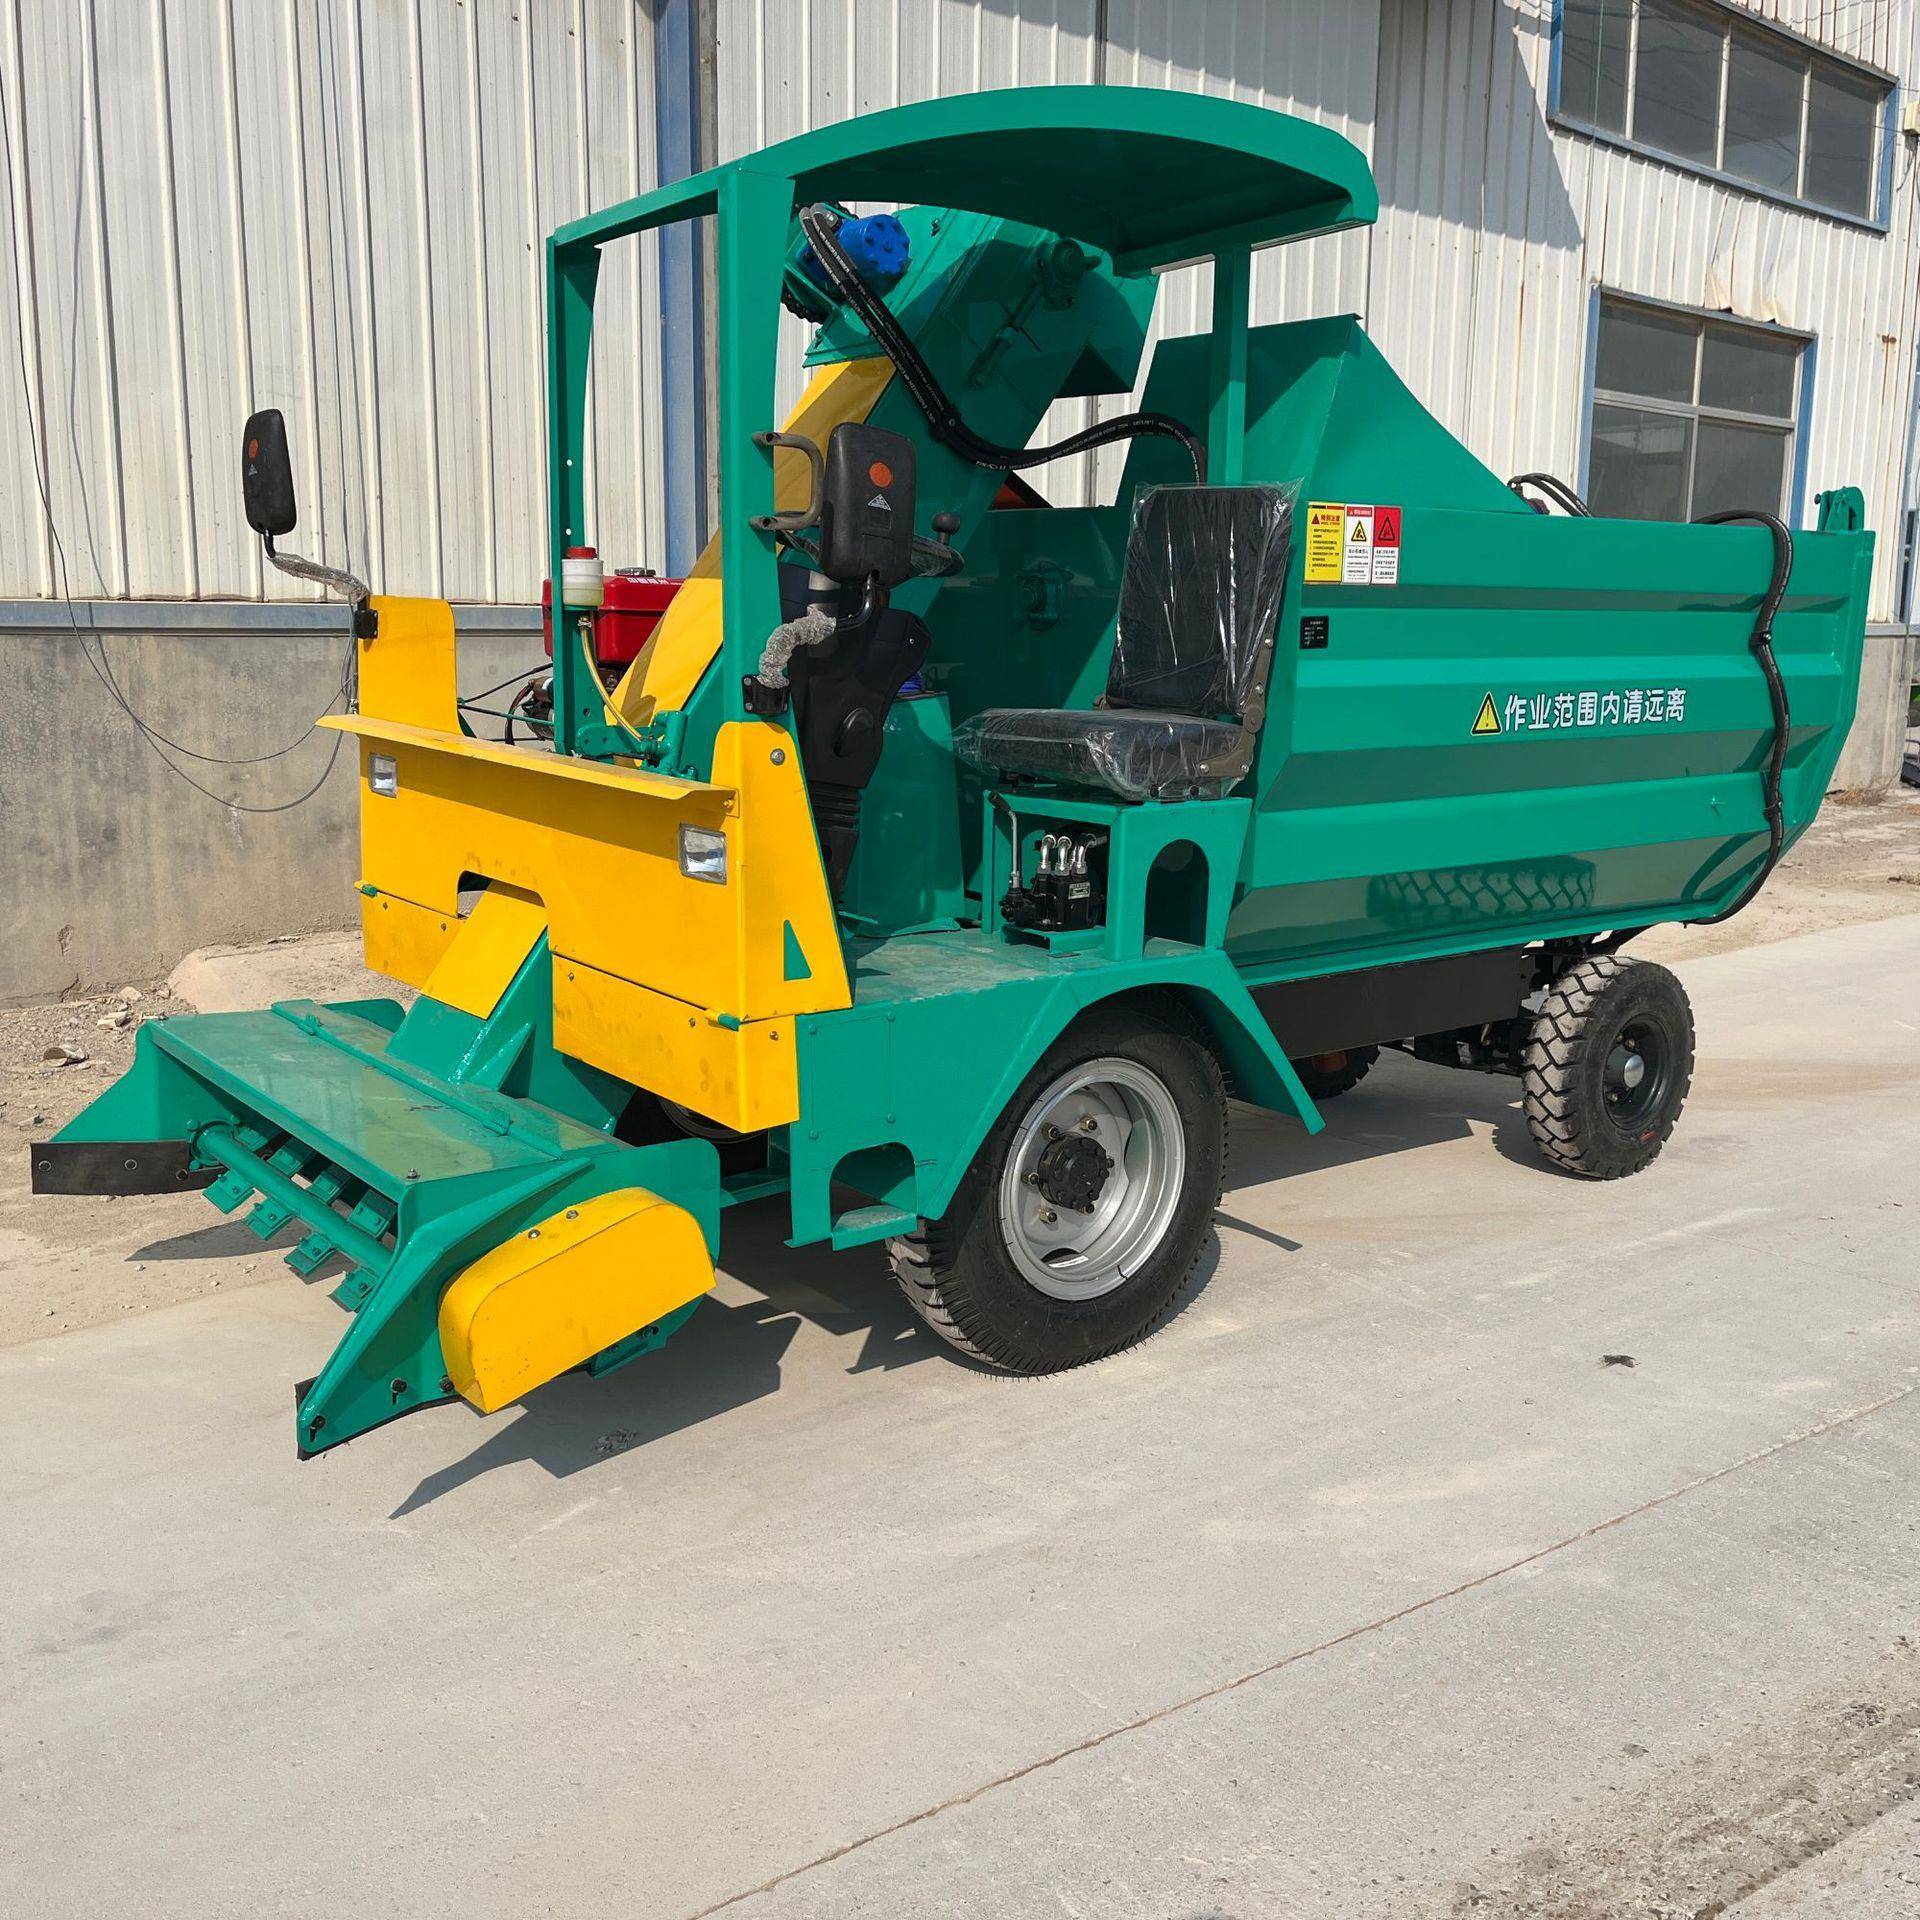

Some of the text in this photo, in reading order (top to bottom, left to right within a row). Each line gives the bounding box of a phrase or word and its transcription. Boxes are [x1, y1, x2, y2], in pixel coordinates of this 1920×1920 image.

[1504, 687, 1687, 732] 作业范围内请远离
